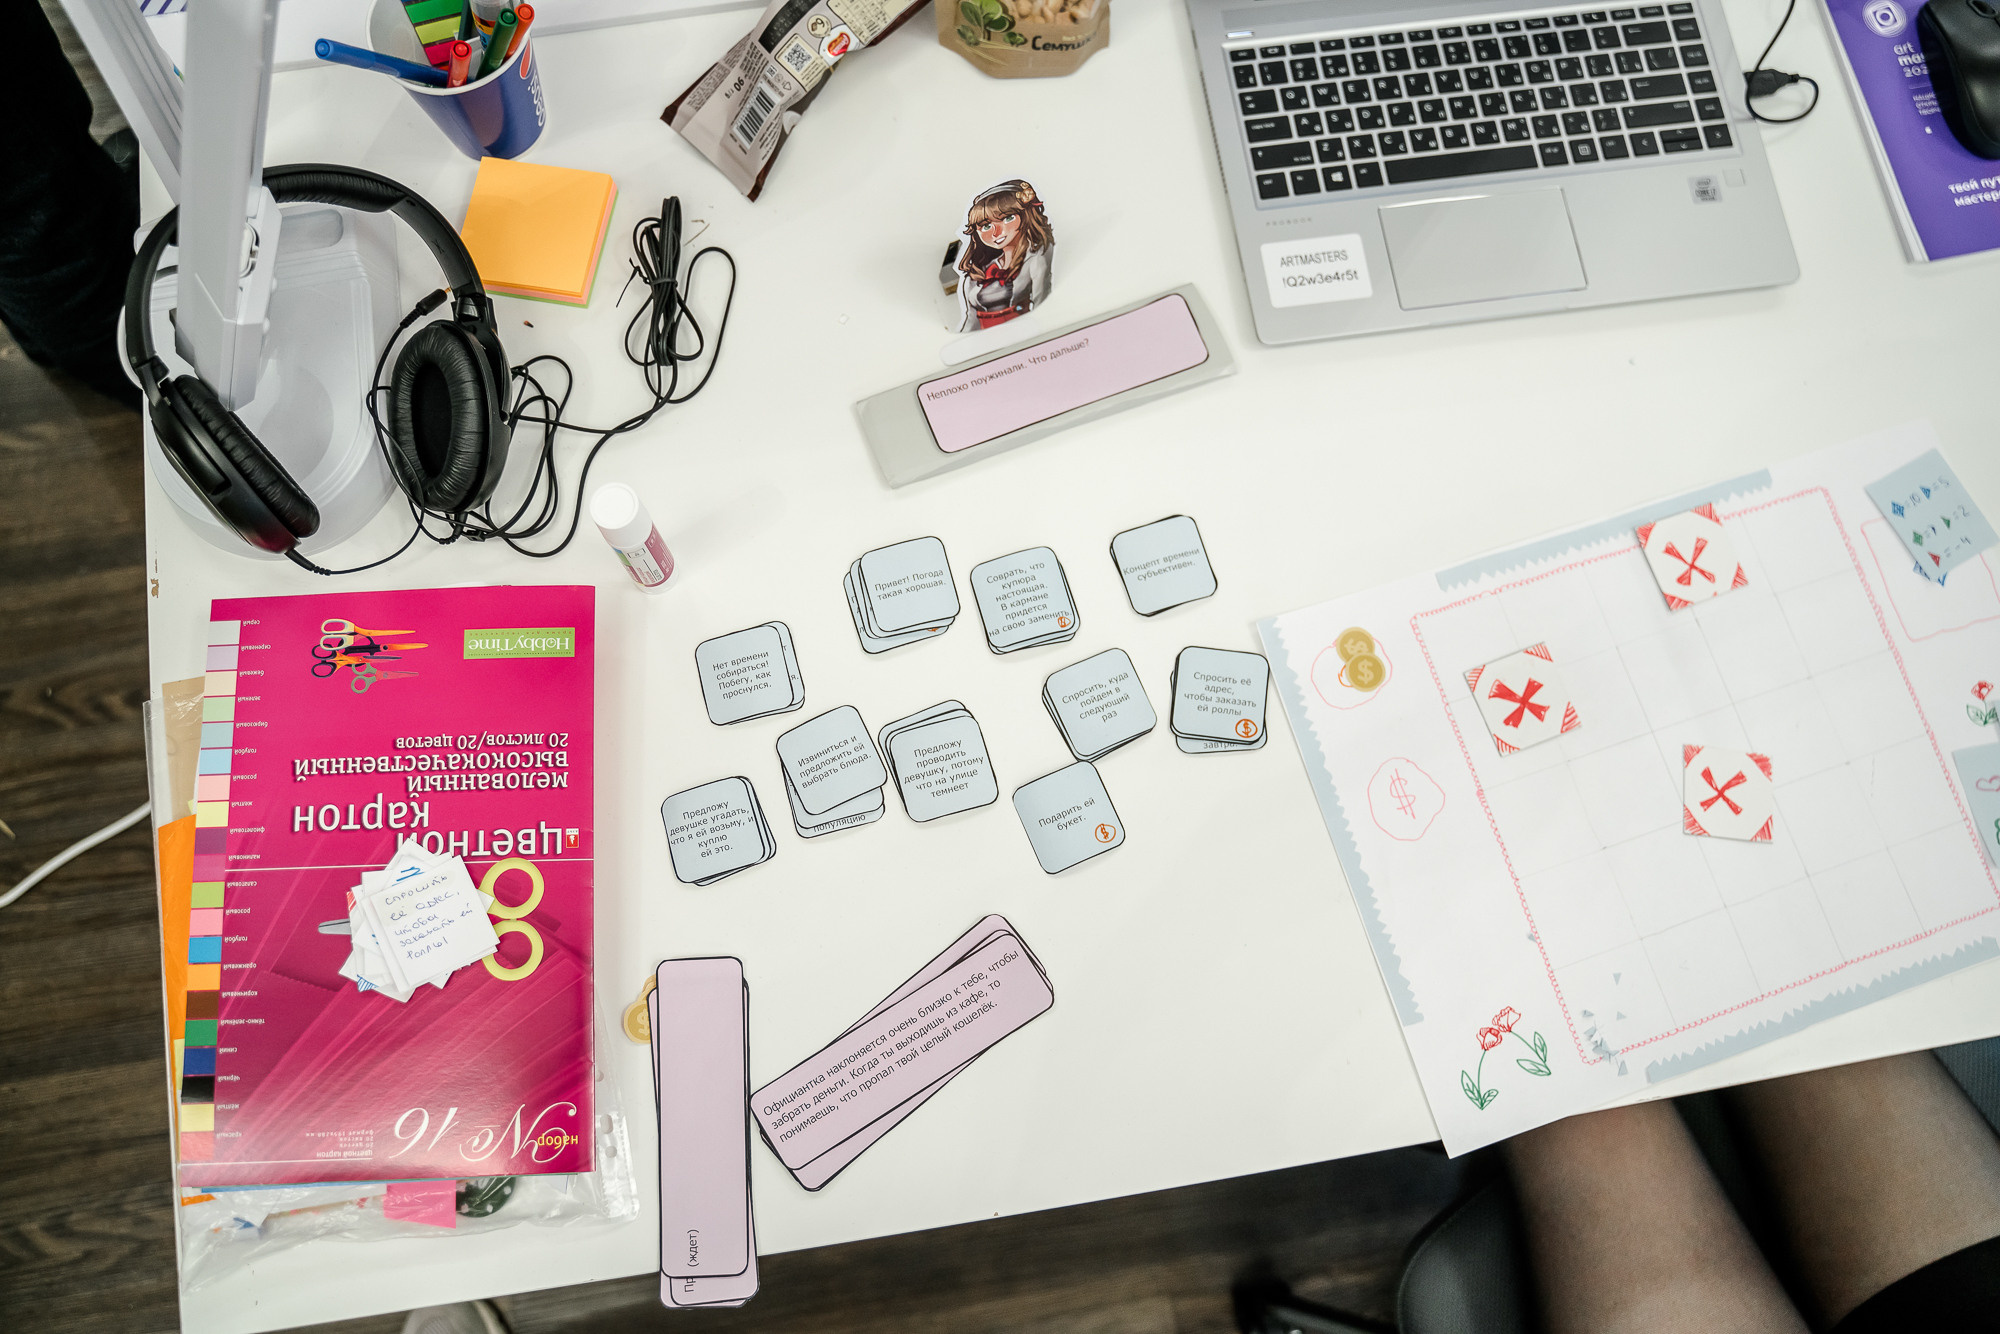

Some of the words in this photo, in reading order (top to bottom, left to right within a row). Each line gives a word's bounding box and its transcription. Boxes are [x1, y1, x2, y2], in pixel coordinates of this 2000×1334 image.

[1893, 41, 1915, 55] art
[1903, 64, 1929, 78] 202
[1948, 177, 1980, 194] твой
[1954, 189, 2000, 207] мастер
[1280, 249, 1349, 268] ARTMASTERS
[926, 382, 969, 401] Неплохо
[970, 362, 1028, 388] поужинали.
[1028, 354, 1047, 366] Что
[1049, 338, 1090, 360] дальше?
[1122, 558, 1160, 576] Концепт
[1163, 548, 1200, 563] времени
[1136, 559, 1196, 582] субъективен.
[874, 575, 911, 592] Привет!
[912, 569, 944, 582] Погода
[986, 567, 1028, 585] Соврать,
[1029, 561, 1045, 571] что
[1001, 573, 1037, 590] купюра
[877, 588, 903, 602] такая
[905, 579, 947, 596] хорошая.
[995, 584, 1048, 603] настоящая.
[1001, 602, 1008, 611] В
[1010, 592, 1049, 610] кармане
[1004, 603, 1048, 621] придется
[988, 627, 1000, 638] на
[1002, 619, 1026, 633] свою
[1028, 610, 1073, 626] заменить.
[468, 635, 570, 652] HobbyTime
[712, 660, 728, 672] Нет
[731, 651, 769, 666] времени
[716, 661, 770, 680] собираться!
[718, 675, 753, 690] Побегу,
[755, 670, 772, 680] как
[1193, 671, 1238, 685] Спросить
[722, 682, 772, 700] проснулся.
[1061, 682, 1107, 705] Спросить,
[1108, 671, 1129, 685] куда
[1204, 684, 1235, 695] адрес,
[1078, 692, 1131, 721] следующий
[1080, 690, 1113, 708] пойдем
[1183, 691, 1213, 702] чтобы
[1215, 696, 1257, 708] заказать
[1101, 709, 1118, 723] раз
[1197, 702, 1209, 713] ей
[1211, 705, 1242, 717] роллы
[396, 735, 453, 749] цветов
[457, 731, 544, 750] листов/20
[549, 733, 569, 747] 20
[914, 738, 963, 758] Предложу
[797, 740, 849, 768] Извиниться
[850, 735, 858, 743] и
[799, 750, 852, 779] предложить
[853, 742, 866, 755] ей
[915, 750, 967, 769] проводить
[294, 751, 569, 781] высококачественный
[801, 765, 839, 789] выбрать
[840, 754, 872, 772] блюда.
[903, 765, 949, 785] девушку,
[950, 756, 985, 772] потому
[407, 771, 569, 797] мелованный
[915, 781, 933, 792] что
[934, 777, 947, 786] на
[949, 768, 979, 784] улице
[931, 781, 970, 799] темнеет
[294, 792, 430, 832] картон
[682, 799, 729, 820] Предложу
[1038, 803, 1083, 828] Подарить
[1084, 797, 1096, 808] ей
[669, 817, 709, 837] девушке
[710, 807, 750, 826] угадать,
[813, 814, 866, 833] популяцию
[1056, 815, 1087, 831] букет.
[670, 835, 685, 847] что
[695, 826, 708, 838] ей
[709, 819, 746, 837] возьму,
[697, 834, 728, 849] куплю
[700, 847, 713, 858] ей
[714, 844, 734, 856] это.
[763, 1072, 826, 1117] Официантка
[826, 1033, 887, 1078] наклоняется
[888, 1016, 918, 1037] очень
[917, 991, 953, 1019] близко
[954, 988, 962, 997] к
[961, 969, 989, 991] тебе,
[988, 949, 1020, 974] чтобы
[771, 1102, 812, 1130] забрать
[812, 1078, 851, 1106] деньги.
[849, 1055, 880, 1081] Когда
[880, 1046, 895, 1060] ты
[895, 1018, 946, 1051] выходишь
[945, 1008, 959, 1020] из
[959, 988, 989, 1015] кафе,
[988, 979, 1002, 991] то
[779, 1103, 840, 1143] понимаешь,
[839, 1088, 858, 1104] что
[858, 1064, 896, 1092] пропал
[895, 1047, 920, 1068] твой
[920, 1028, 953, 1054] целый
[952, 1001, 999, 1032] кошелёк.
[537, 1133, 579, 1150] набор
[316, 1149, 342, 1158] картон
[343, 1149, 373, 1158] цветной
[687, 1229, 700, 1267] (ждет)
